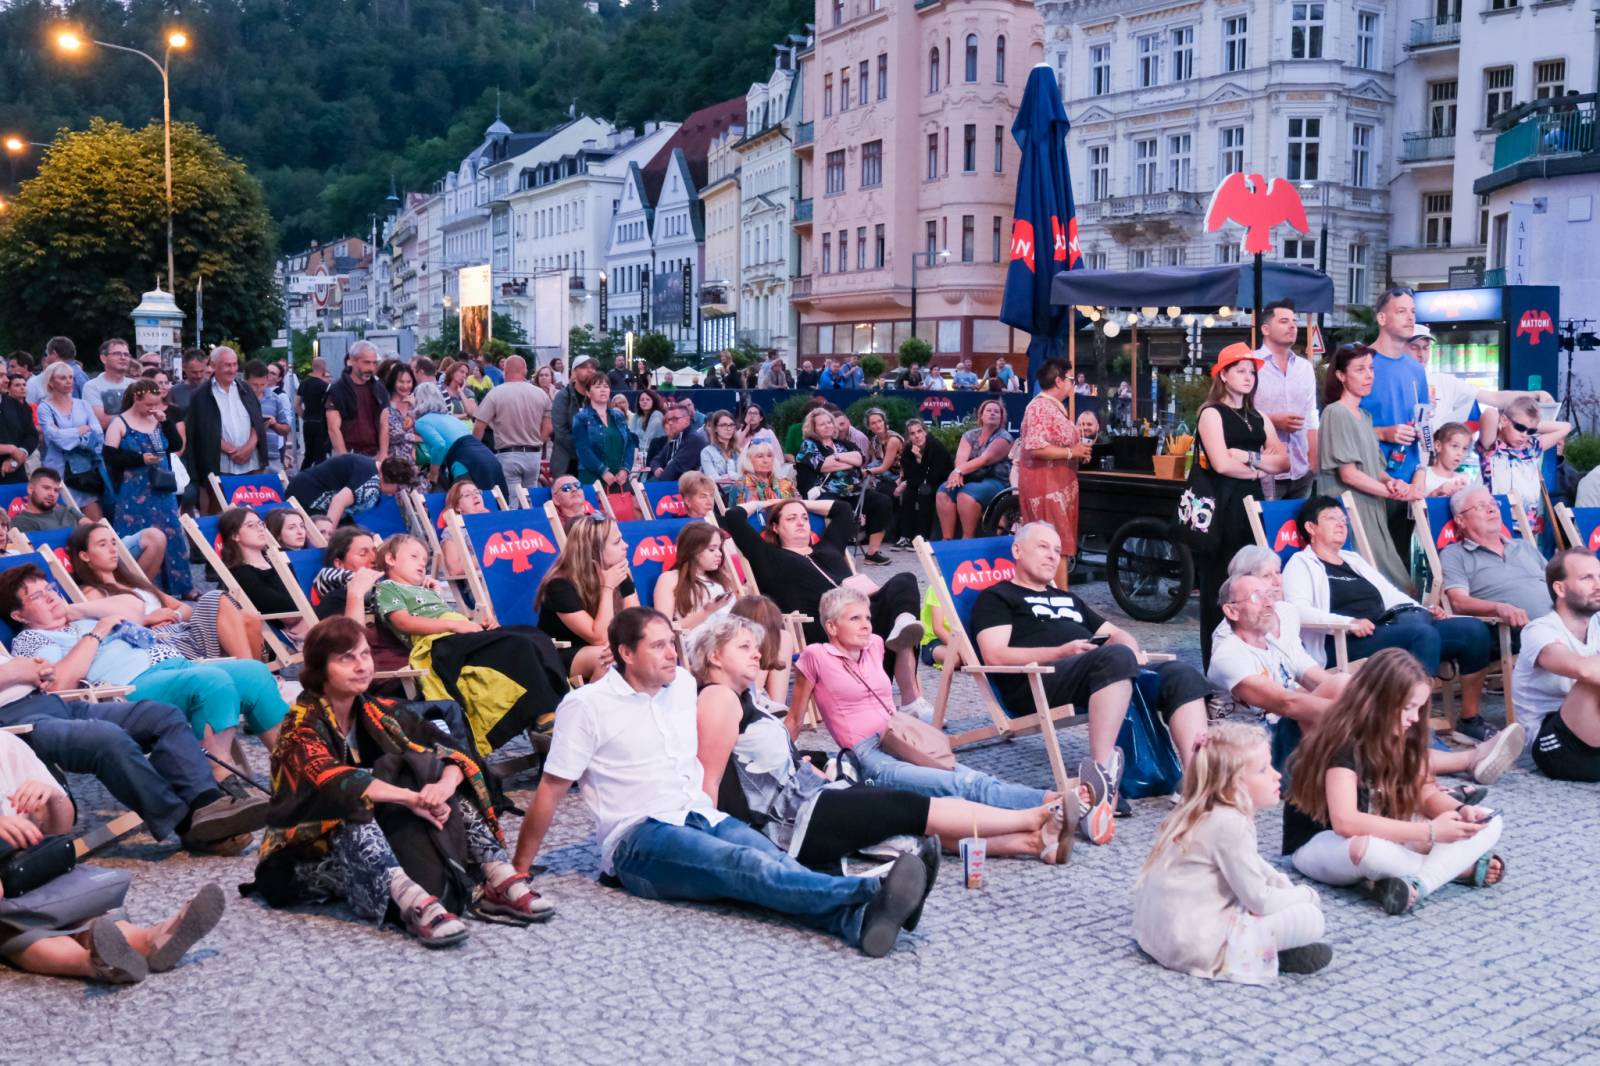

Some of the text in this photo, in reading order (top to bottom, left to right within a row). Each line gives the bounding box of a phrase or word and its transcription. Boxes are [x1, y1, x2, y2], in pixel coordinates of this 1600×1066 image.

[1521, 319, 1550, 329] MATTONI
[235, 491, 276, 499] MATTONI
[488, 538, 544, 555] MATTONI
[640, 545, 678, 556] MATT
[957, 568, 1016, 583] MATTONI
